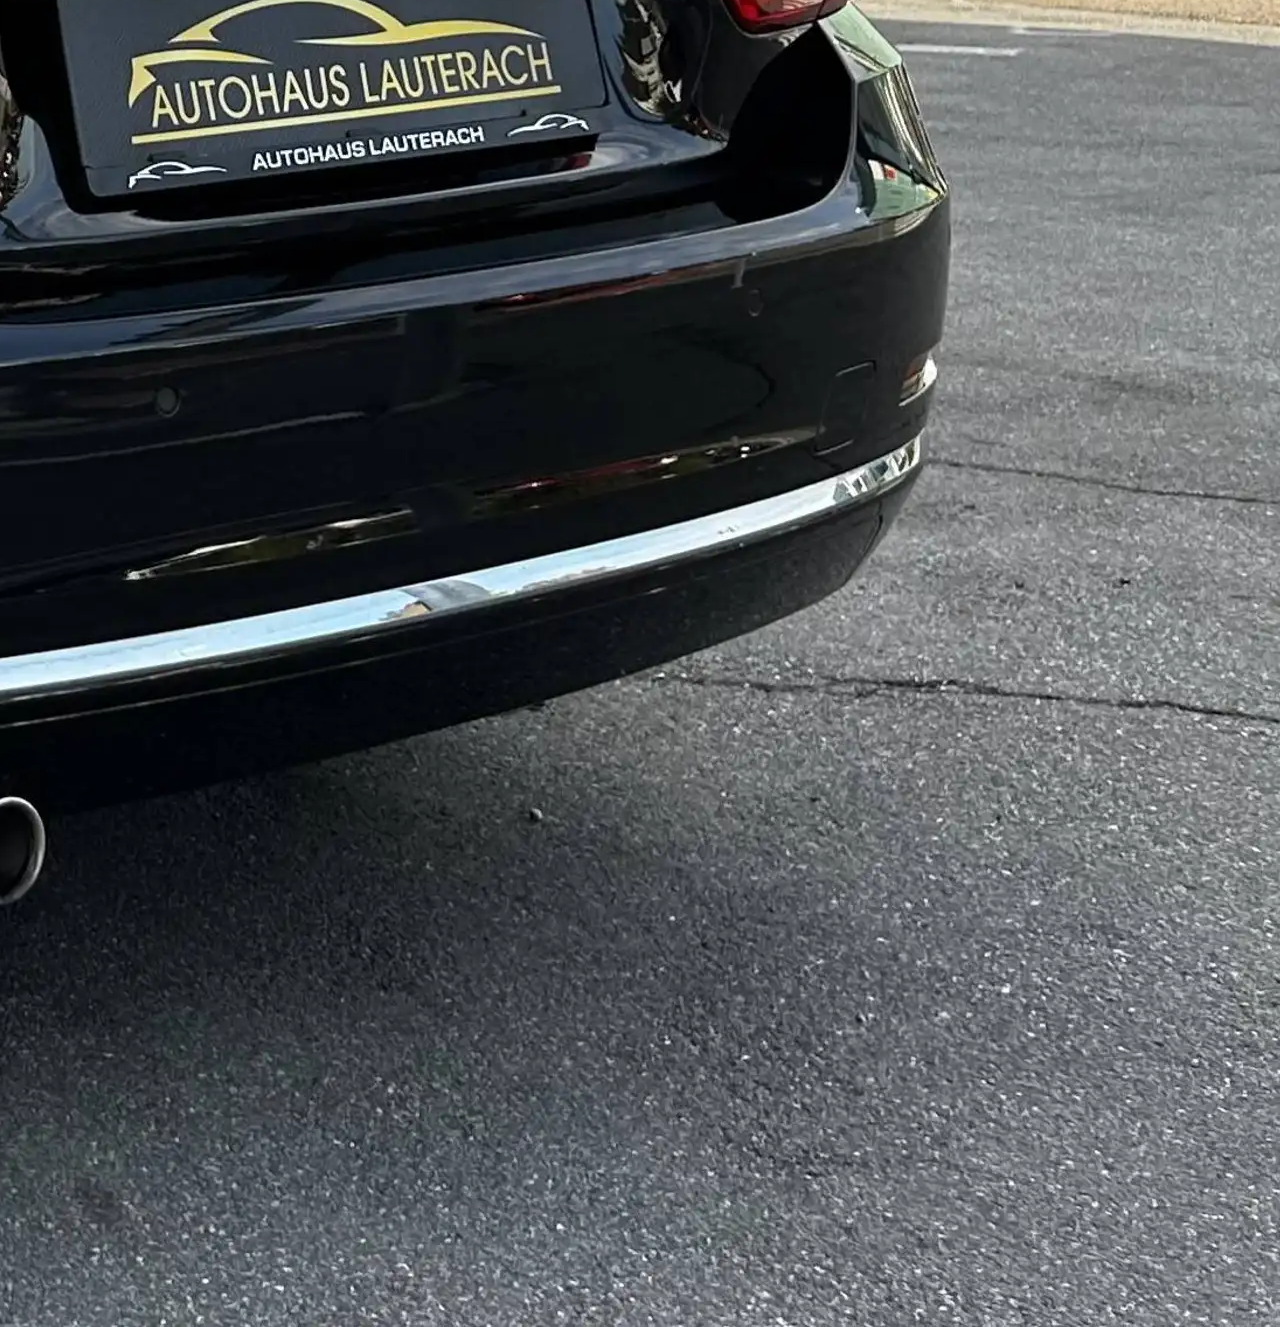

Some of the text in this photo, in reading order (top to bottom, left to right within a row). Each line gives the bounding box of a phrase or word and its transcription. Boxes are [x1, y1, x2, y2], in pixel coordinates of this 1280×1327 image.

[151, 42, 553, 128] AUTOHAUS LAUTERACH
[252, 126, 485, 171] AUTOHAUS LAUTERACH
